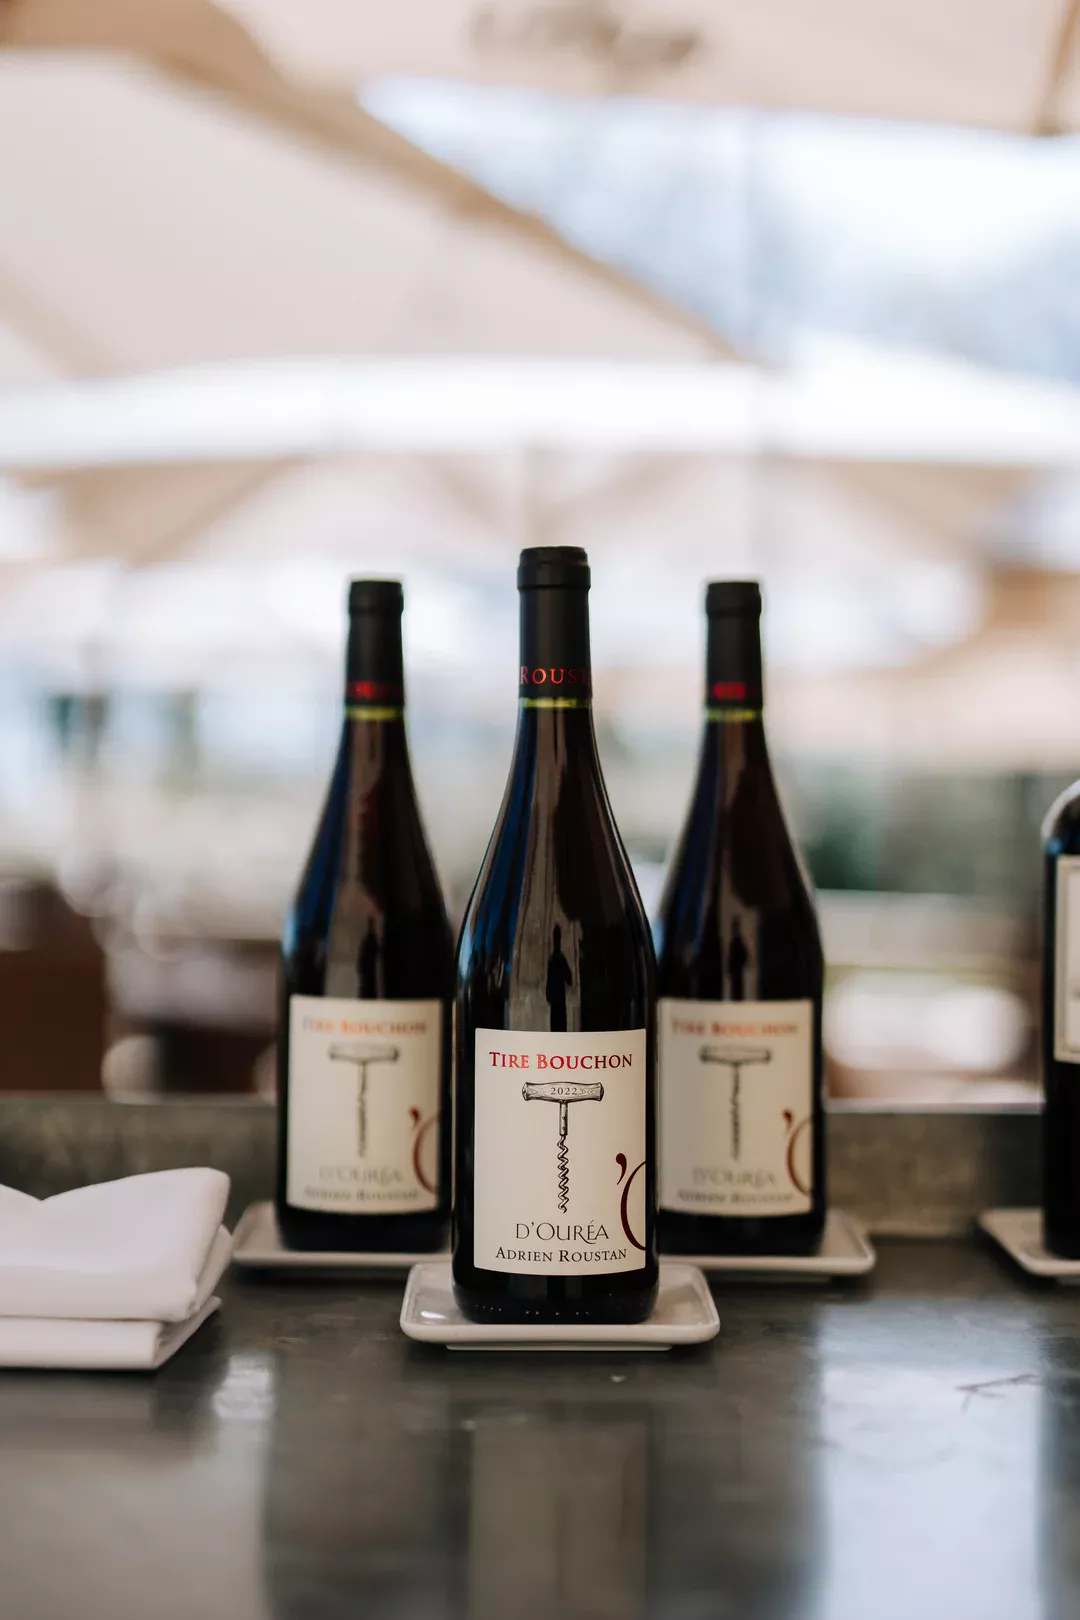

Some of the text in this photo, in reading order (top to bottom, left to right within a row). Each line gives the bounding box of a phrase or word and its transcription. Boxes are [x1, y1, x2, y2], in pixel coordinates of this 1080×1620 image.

[489, 1051, 633, 1070] TIRE BOUCHON
[550, 1087, 578, 1095] 2022
[495, 1246, 628, 1263] ADRIEN ROUSTAN
